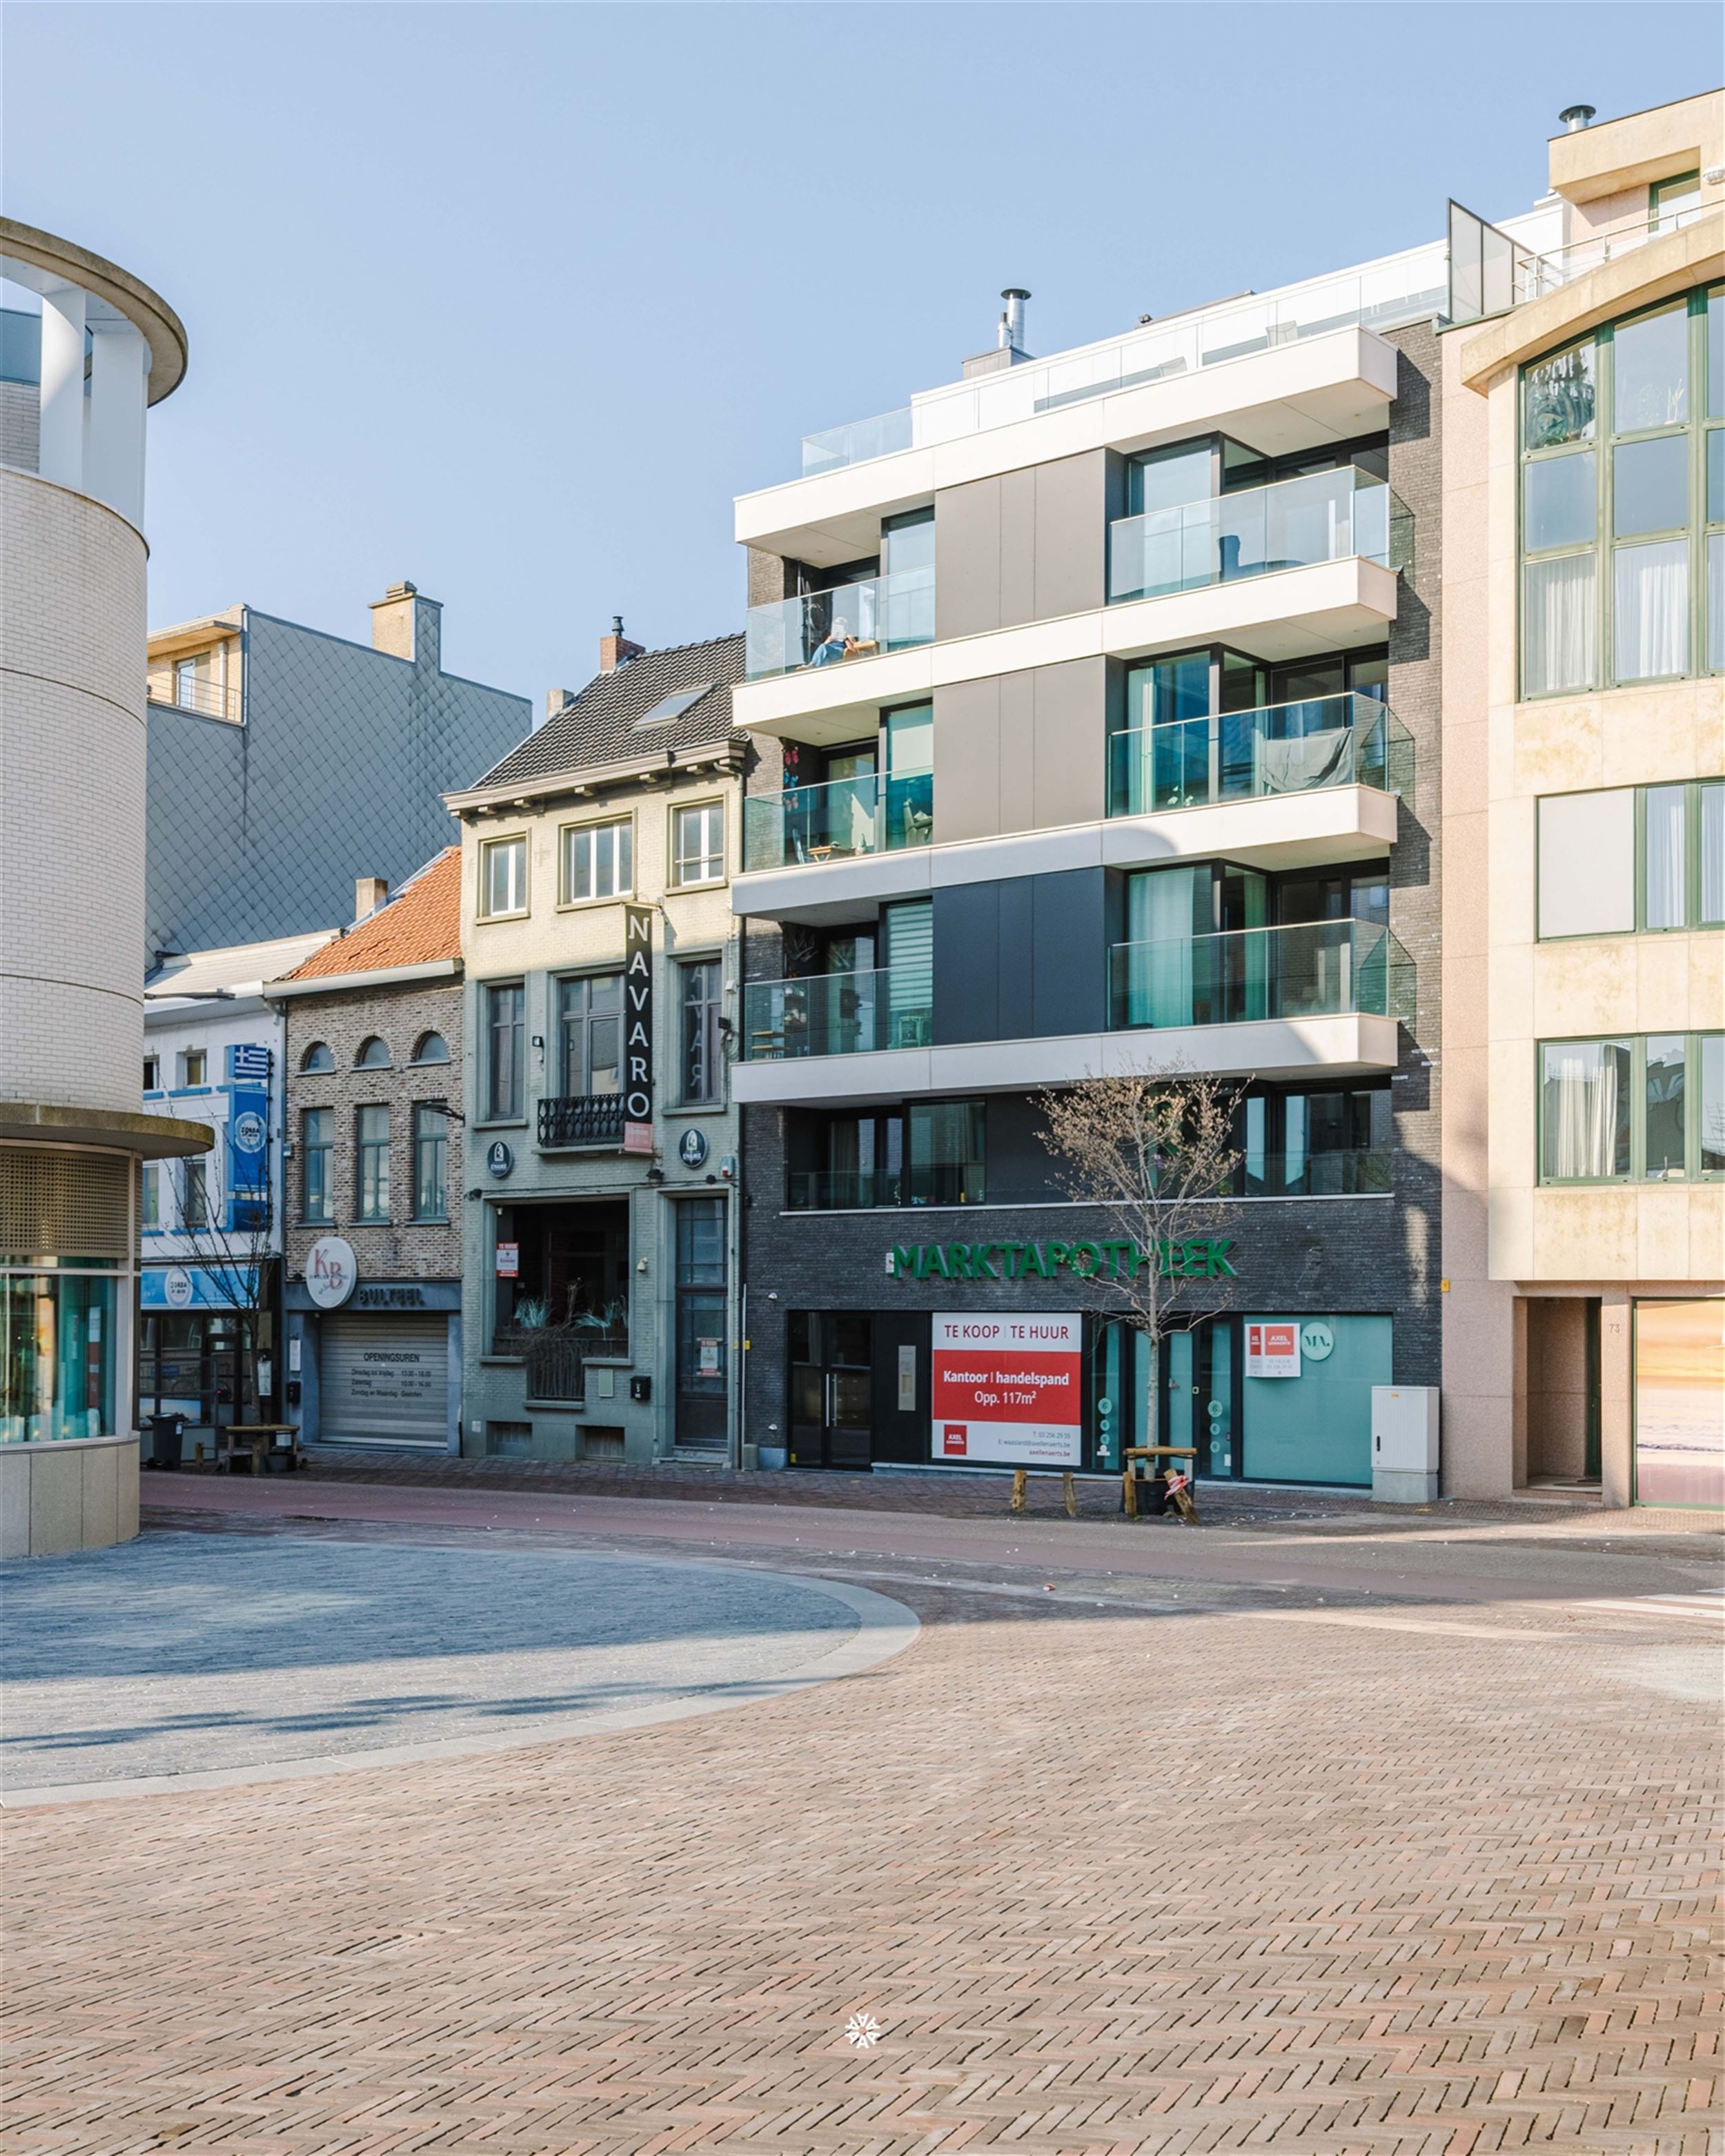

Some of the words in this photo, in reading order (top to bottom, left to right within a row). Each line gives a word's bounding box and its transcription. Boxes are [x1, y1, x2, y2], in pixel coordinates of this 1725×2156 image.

[627, 915, 650, 1117] NAVARO
[893, 1238, 1236, 1278] MARKTAPOTHEEK
[359, 1288, 424, 1305] BULTEEL
[944, 1325, 958, 1338] TE
[963, 1325, 1000, 1338] KOOP
[1010, 1325, 1025, 1338] TE
[1029, 1326, 1070, 1339] HUUR
[364, 1352, 420, 1363] OPENINGSUREN
[943, 1370, 988, 1383] Kantoor
[996, 1371, 1069, 1388] handelspand
[974, 1390, 1000, 1407] Opp.
[1029, 1449, 1070, 1457] axellenaerts.be
